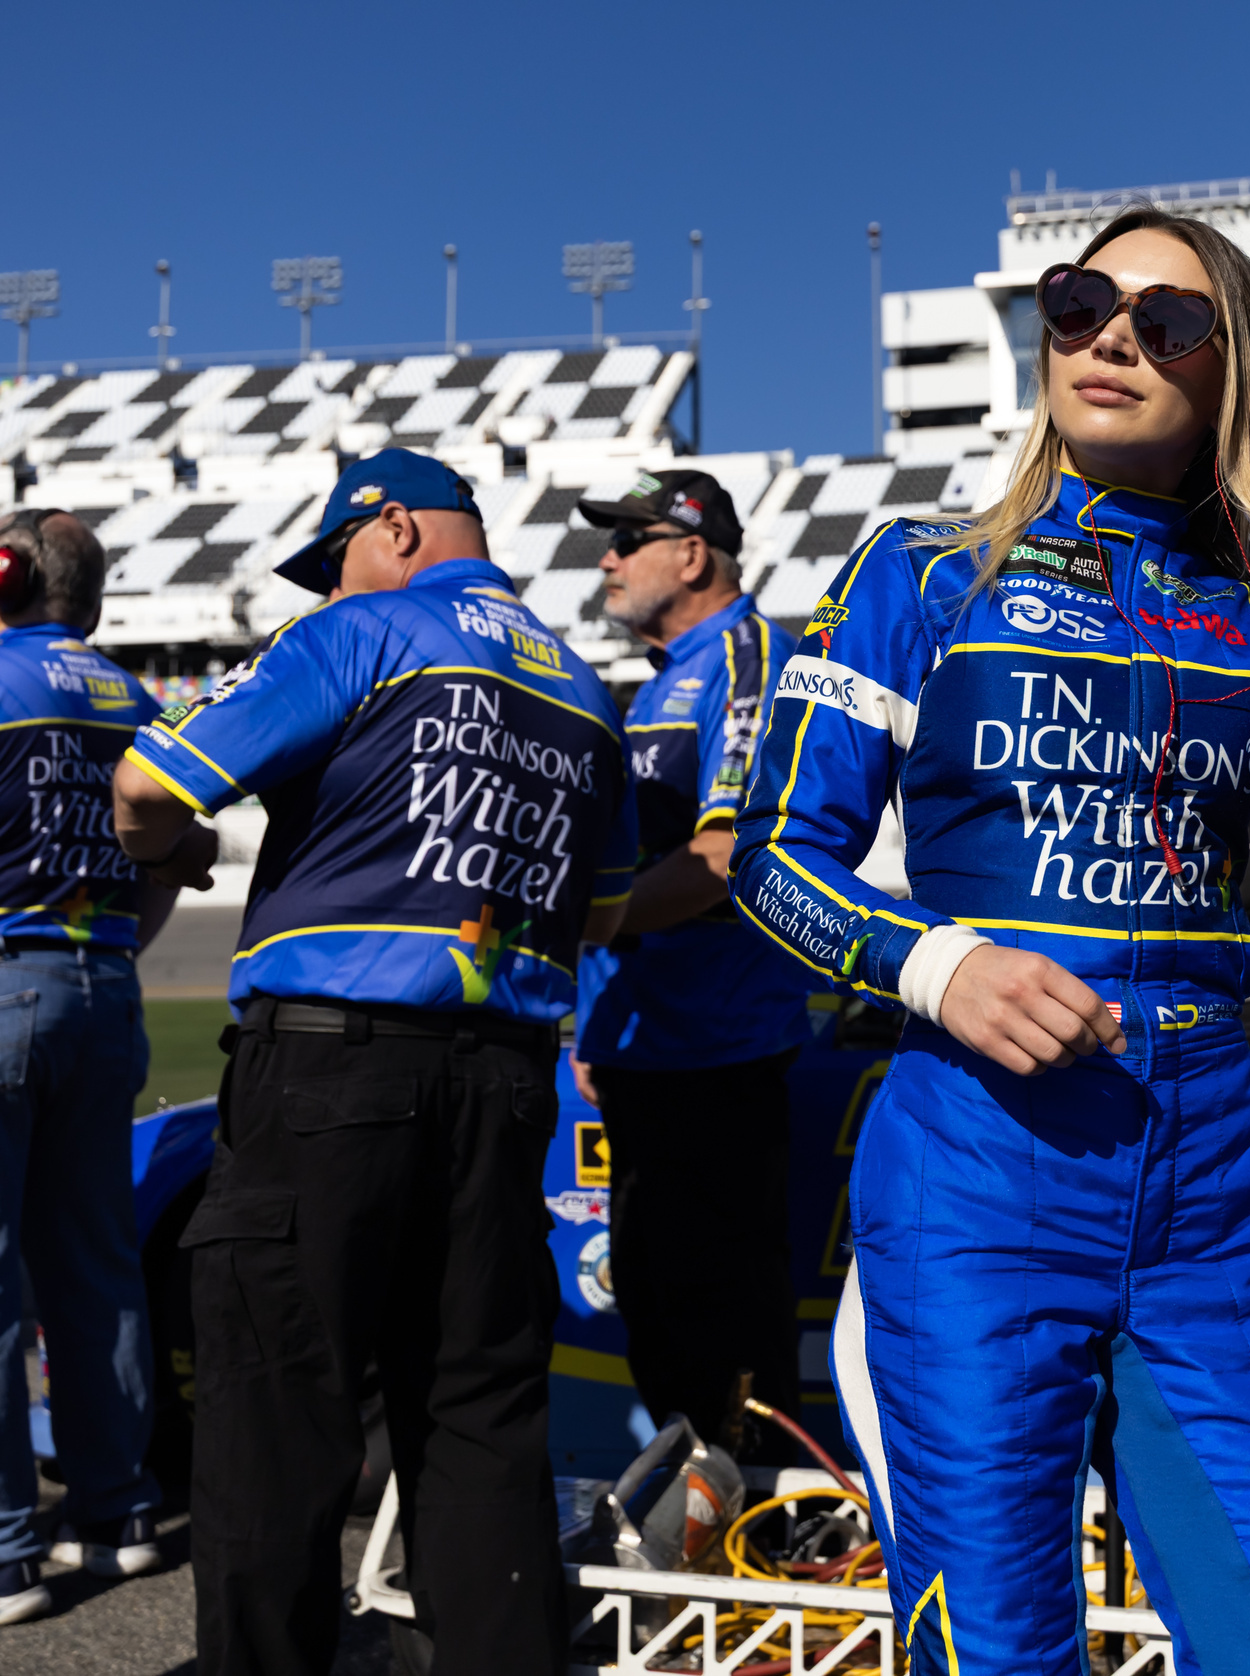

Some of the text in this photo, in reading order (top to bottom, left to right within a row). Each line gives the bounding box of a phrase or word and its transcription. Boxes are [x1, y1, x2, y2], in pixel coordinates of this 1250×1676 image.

[1008, 545, 1067, 570] O'Reilly
[1040, 536, 1077, 549] NASCAR
[1073, 557, 1101, 571] AUTO
[1040, 569, 1069, 582] SERIES
[1070, 565, 1103, 581] PARTS
[456, 612, 561, 669] FOR THAT
[47, 671, 84, 693] FOR
[85, 676, 129, 699] THAT
[443, 683, 504, 726] T.N.
[1010, 671, 1102, 725] T.N.
[412, 716, 595, 794] DICKINSON'S
[407, 761, 573, 857] Witch
[1010, 780, 1212, 853] Witch
[405, 813, 572, 912] hazel
[764, 868, 789, 897] T.N.
[1030, 829, 1211, 907] hazel
[755, 885, 799, 938] Witch
[1198, 1003, 1239, 1013] NATALIE
